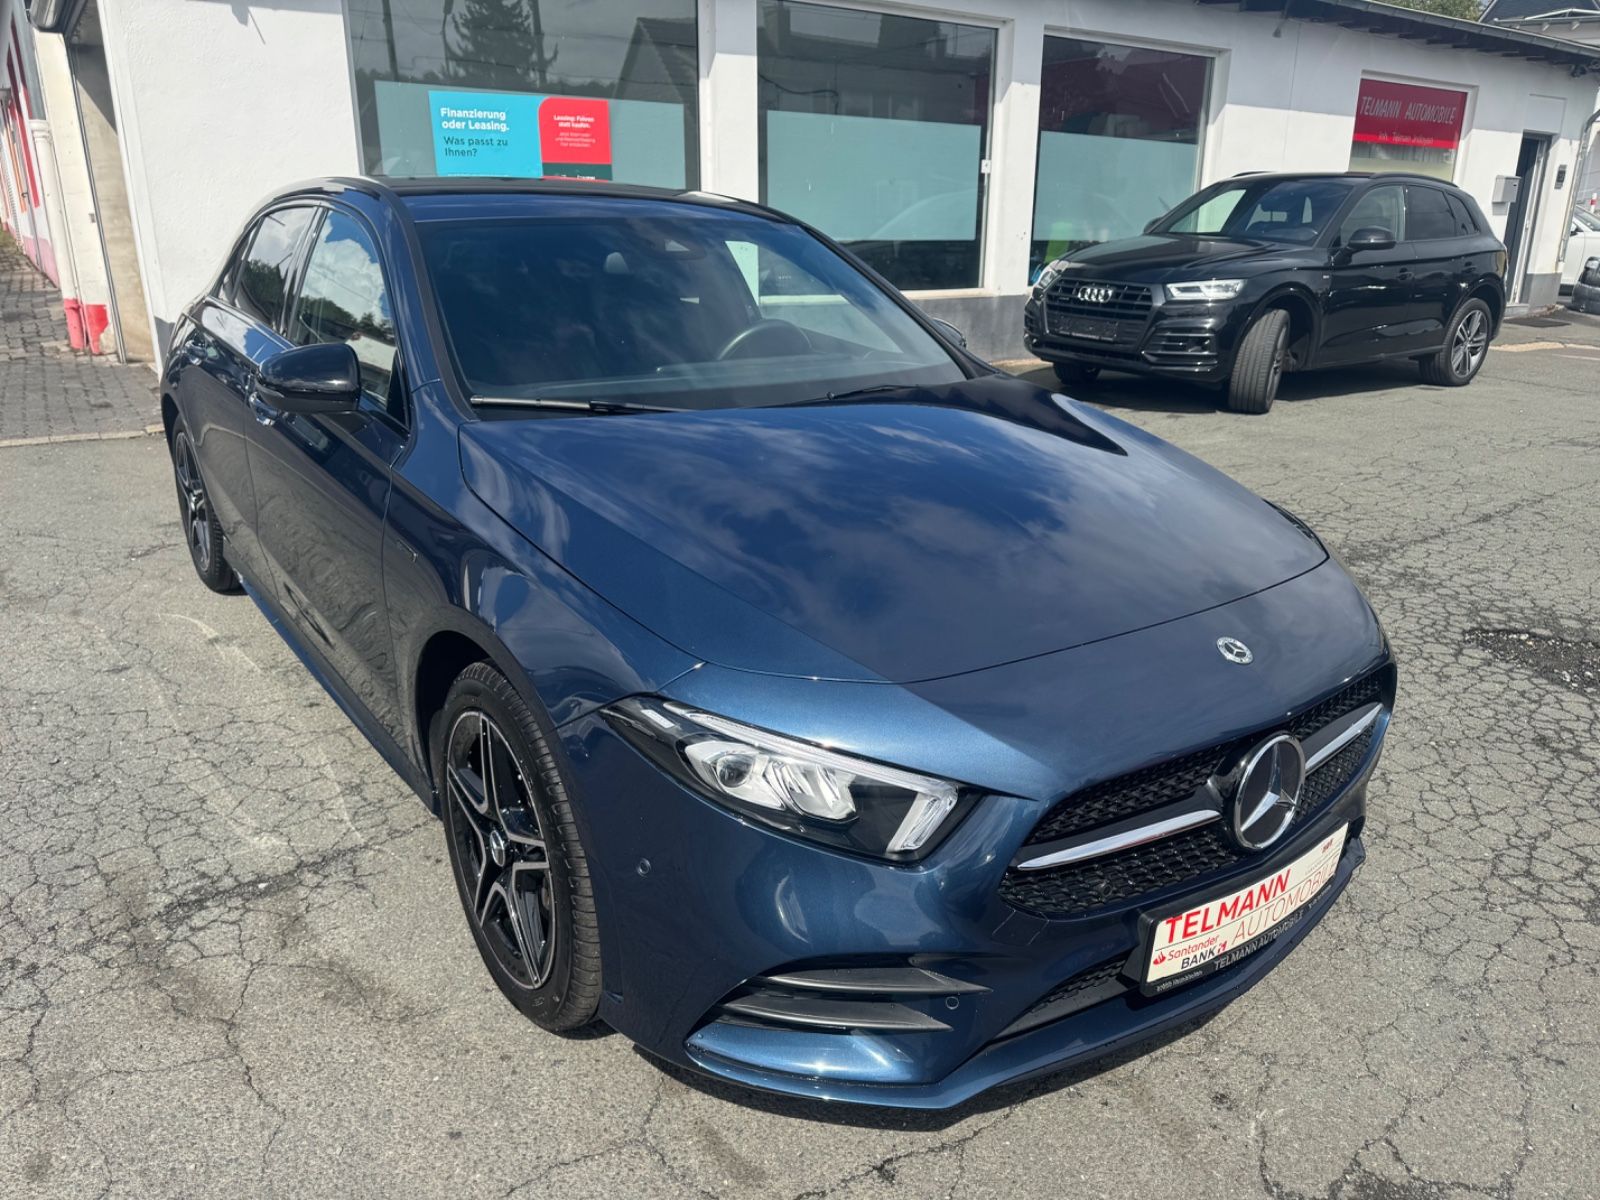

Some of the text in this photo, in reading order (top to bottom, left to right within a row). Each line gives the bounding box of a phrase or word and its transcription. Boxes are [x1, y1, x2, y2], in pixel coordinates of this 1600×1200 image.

[440, 107, 506, 120] Finanzierung
[1359, 96, 1457, 124] TELMANN AUTOMOBILE
[442, 120, 509, 132] oder Leasing.
[444, 136, 508, 148] Was passt zu
[444, 147, 478, 157] Ihnen?
[1165, 869, 1291, 944] TELMANN
[1167, 934, 1219, 962] Santander
[1214, 939, 1261, 971] TELMANN
[1258, 911, 1304, 948] AUTOMOBILE
[1181, 947, 1217, 970] BANK
